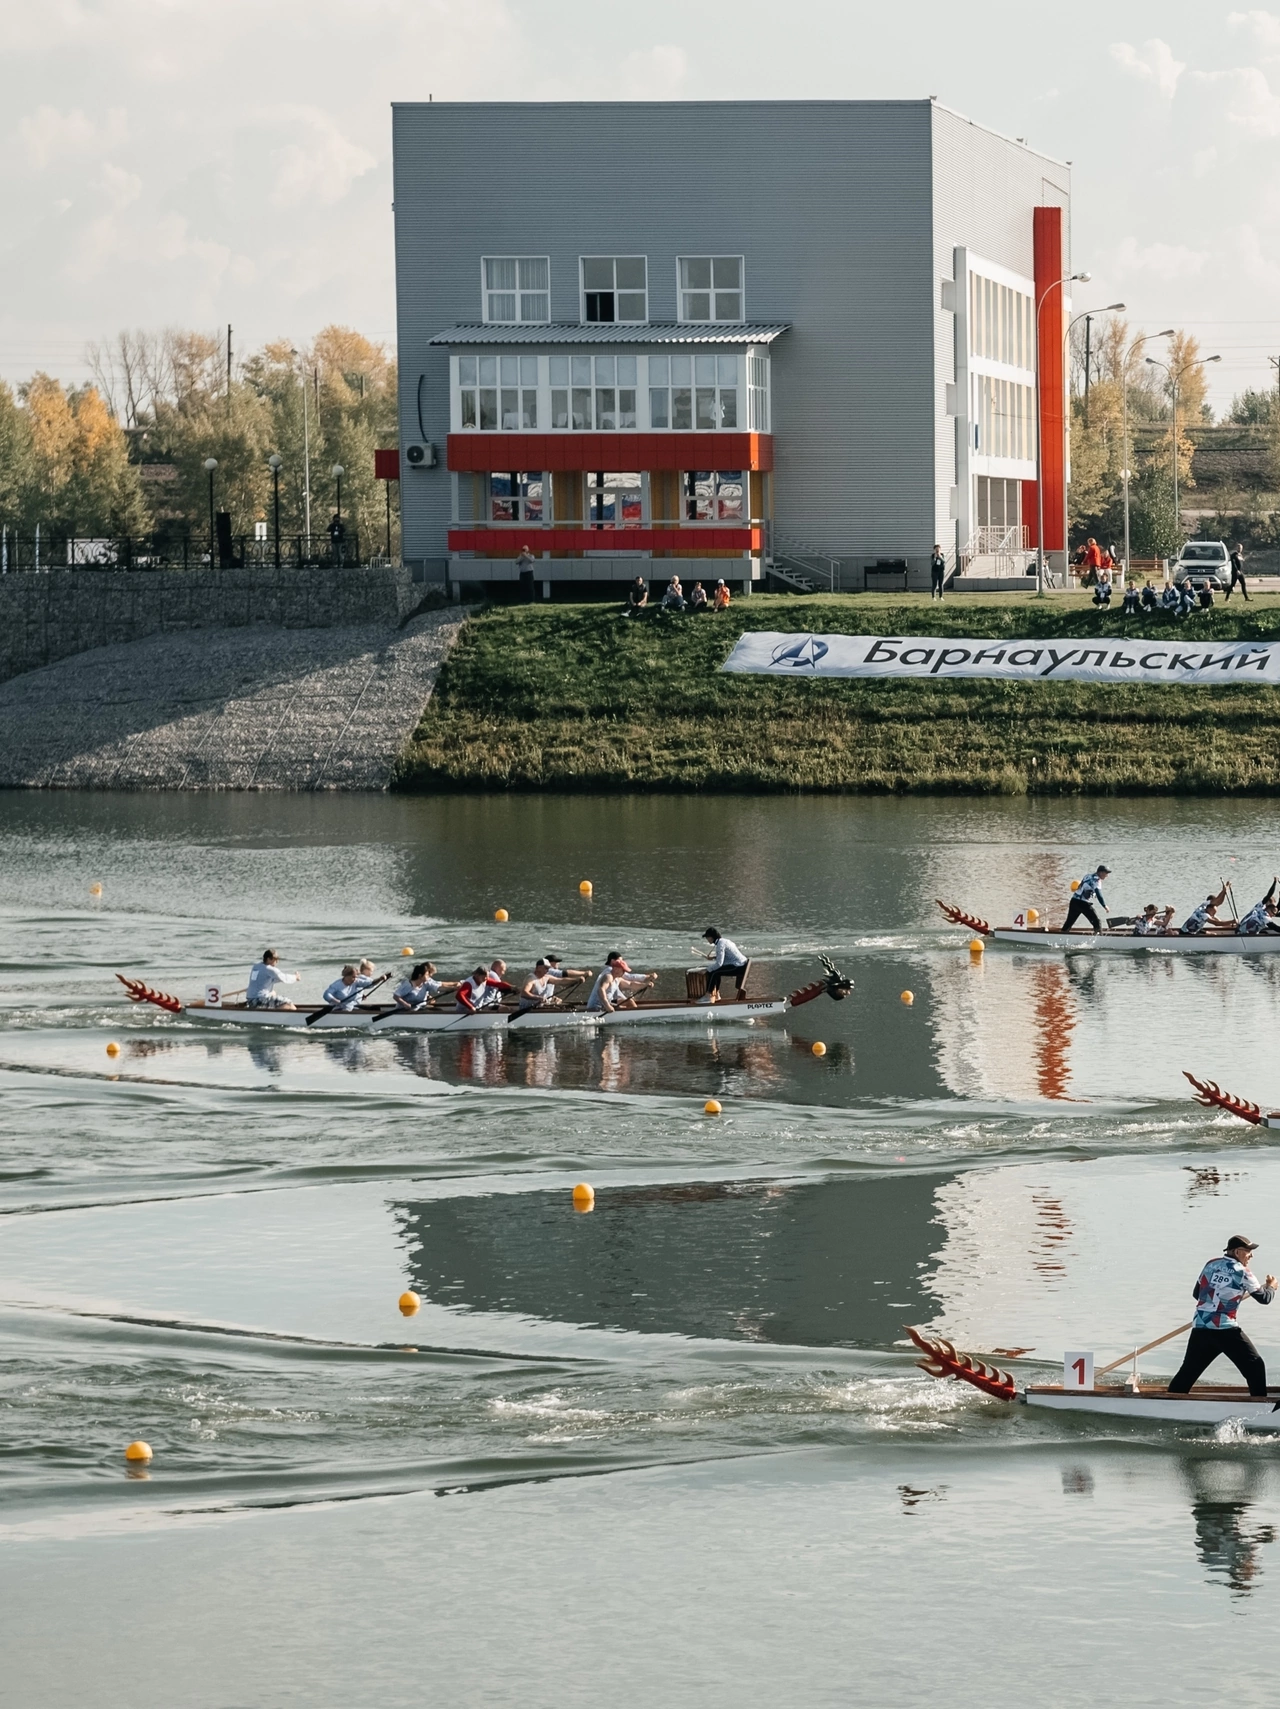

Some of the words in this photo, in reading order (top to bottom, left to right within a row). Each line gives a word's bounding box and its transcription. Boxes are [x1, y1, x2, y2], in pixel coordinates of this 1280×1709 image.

[863, 640, 1272, 676] Барнаульский
[1013, 913, 1025, 927] 4
[208, 987, 220, 1003] 3
[1071, 1357, 1085, 1385] 1
